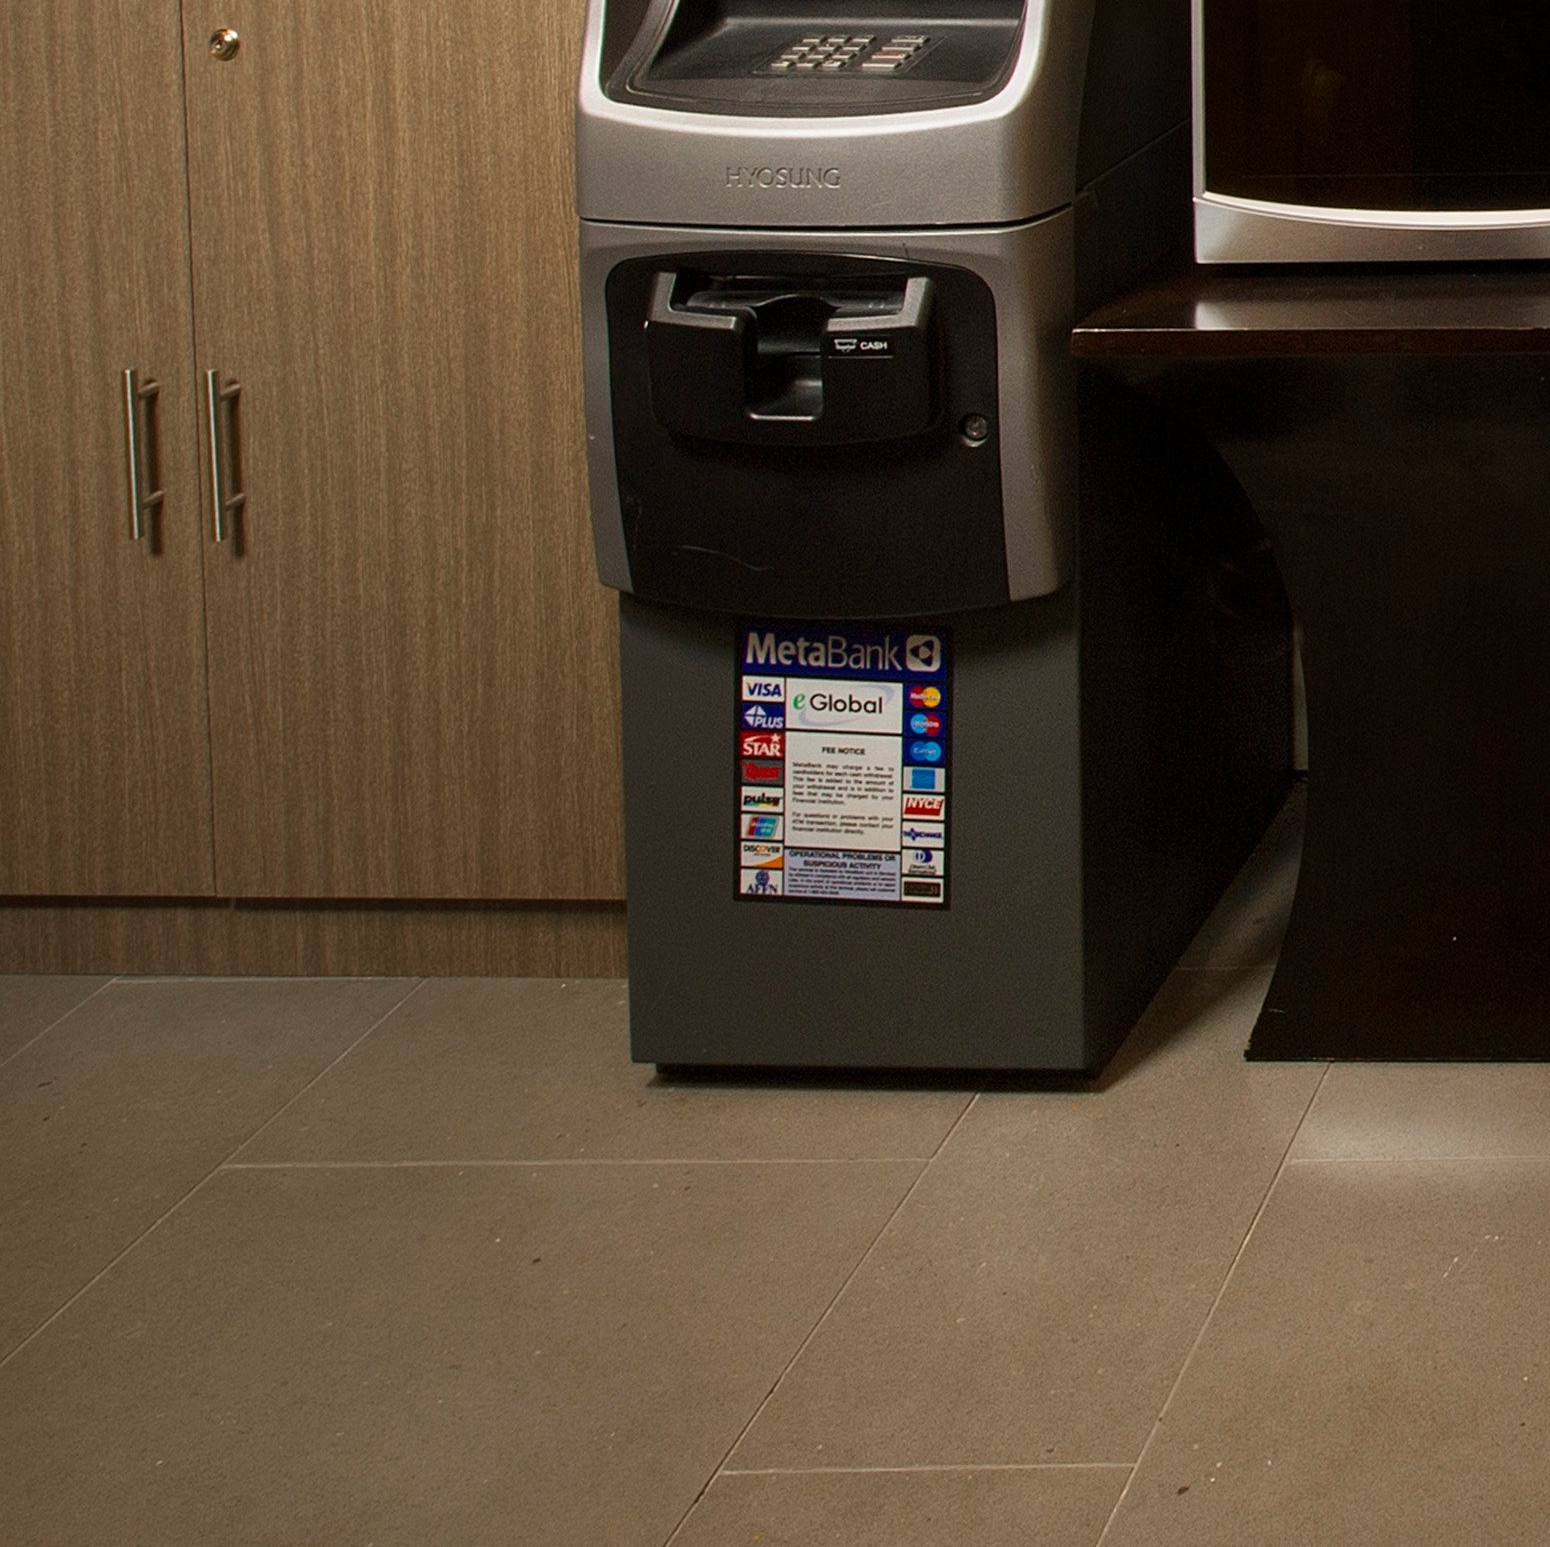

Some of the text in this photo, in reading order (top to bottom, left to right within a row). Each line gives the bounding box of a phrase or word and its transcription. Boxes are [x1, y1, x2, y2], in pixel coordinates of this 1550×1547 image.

[725, 166, 842, 190] HYOSUNG
[859, 340, 888, 351] CASH
[745, 631, 903, 671] MetaBank
[746, 681, 783, 698] VISA
[809, 692, 883, 715] Global
[743, 741, 782, 758] STAR
[821, 746, 866, 756] FEE NOTICE
[906, 797, 941, 810] NYCE
